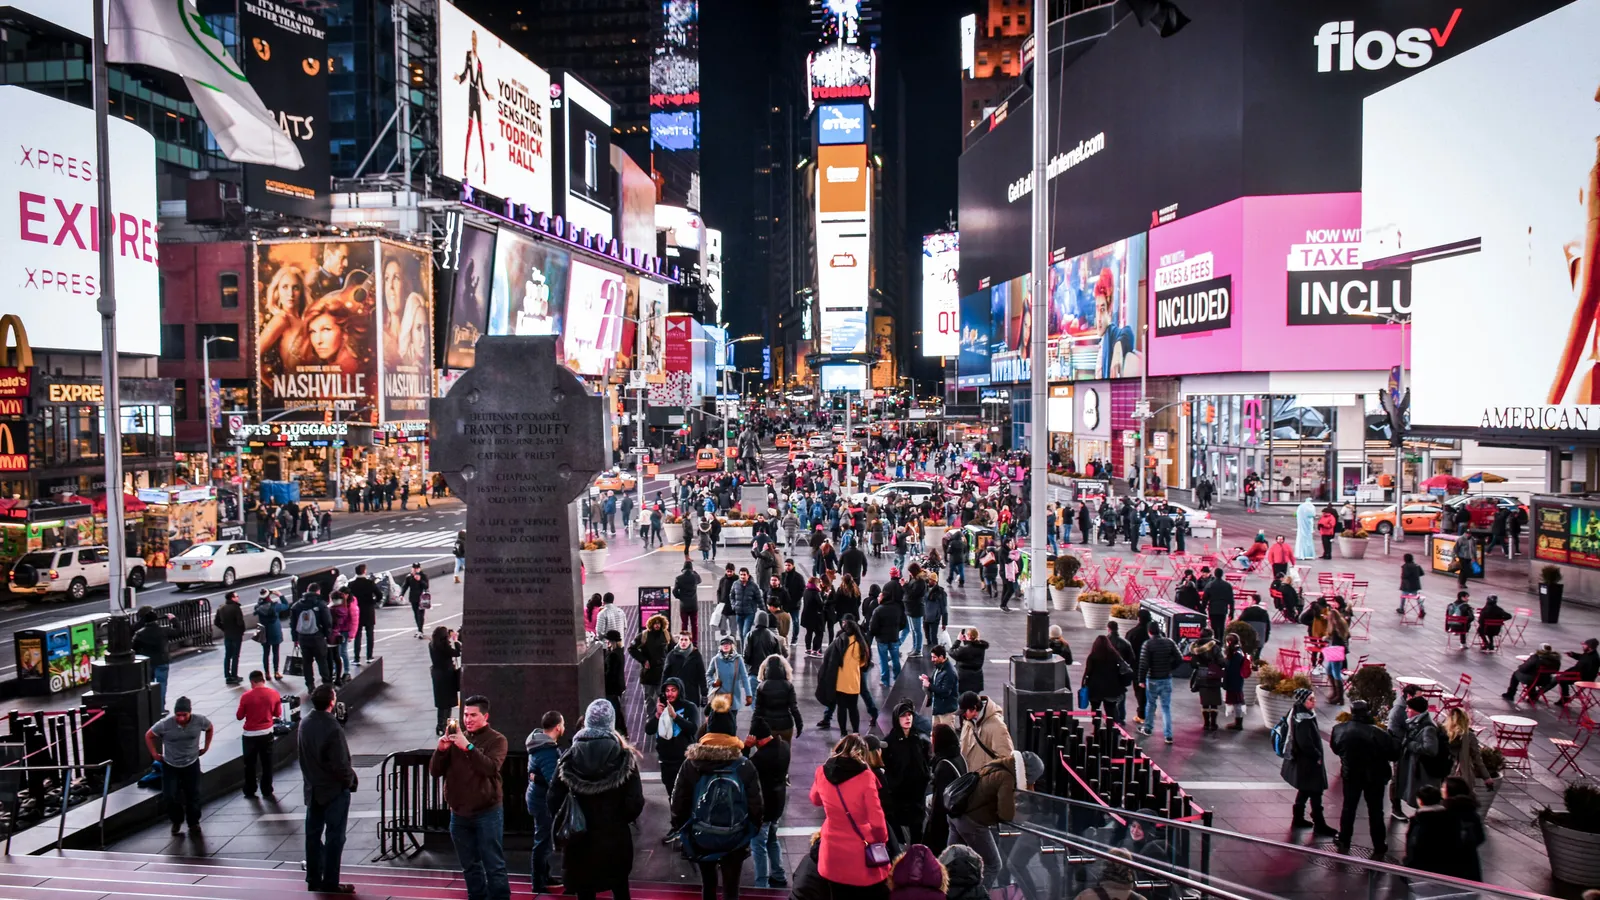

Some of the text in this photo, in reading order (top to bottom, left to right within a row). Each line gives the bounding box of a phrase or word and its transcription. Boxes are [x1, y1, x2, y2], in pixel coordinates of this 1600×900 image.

[275, 4, 296, 20] BACK
[297, 14, 314, 26] AND
[278, 15, 301, 31] THAN
[1313, 20, 1433, 73] fios
[498, 78, 542, 120] YOUTUBE
[811, 84, 871, 98] TOSHIBA
[267, 110, 314, 140] ATS
[498, 100, 542, 137] SENSATION
[498, 118, 543, 158] TODRICK
[20, 144, 98, 182] XPRES
[508, 144, 535, 173] HALL
[505, 197, 663, 275] 1540 BROADWAY
[1306, 228, 1362, 243] NOW WI
[24, 266, 101, 296] XPRES
[1159, 260, 1210, 287] TAXES & FEES
[1158, 287, 1229, 329] INCLUDED
[273, 373, 366, 398] NASHVILLE
[385, 374, 430, 397] NASHVILLE
[469, 412, 563, 421] LIEUTENANT COLONEL
[1480, 407, 1589, 430] AMERICAN
[281, 424, 348, 435] LUGGAGE
[464, 424, 512, 435] FRANCIS
[529, 423, 570, 435] DUFFY
[477, 451, 556, 460] CATHOLIC PRIEST
[519, 485, 557, 493] INFANTRY
[508, 518, 520, 526] OF
[524, 518, 558, 526] SERVICE
[475, 535, 561, 543] GOD AND COUNTRY
